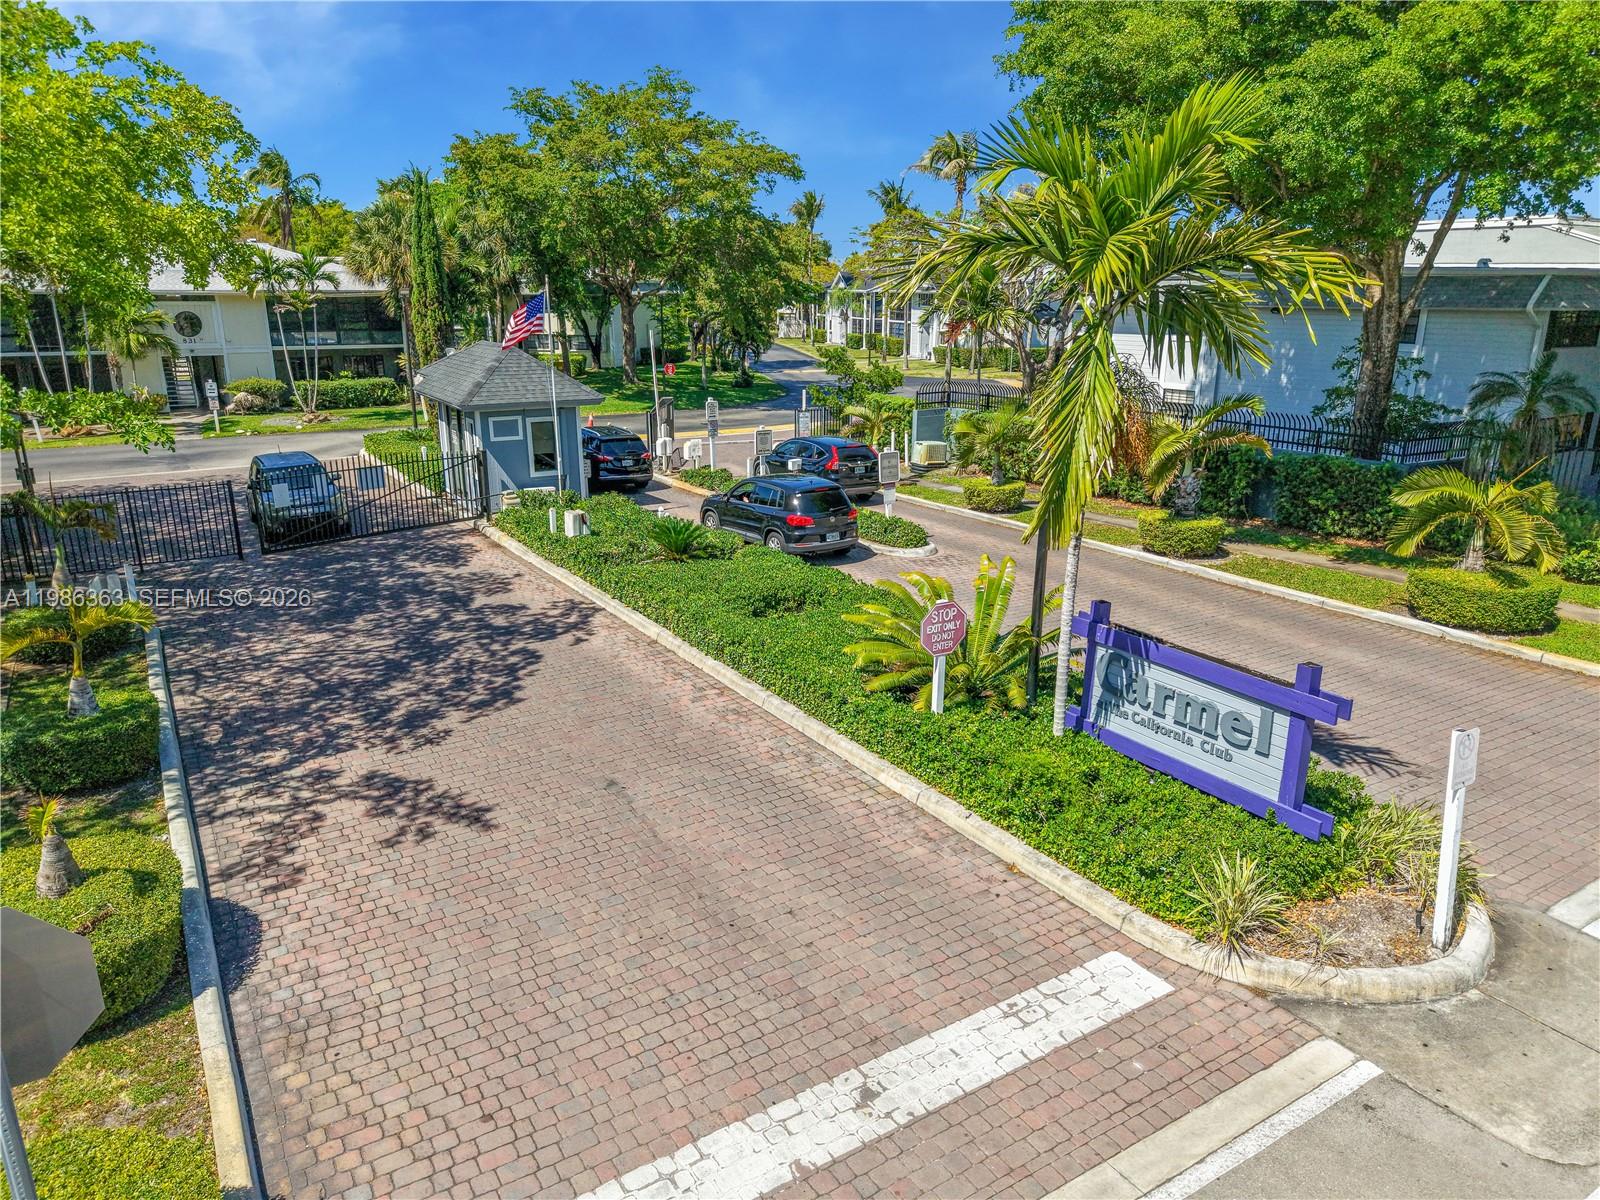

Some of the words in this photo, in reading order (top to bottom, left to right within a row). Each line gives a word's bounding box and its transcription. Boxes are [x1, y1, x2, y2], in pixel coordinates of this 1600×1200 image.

[931, 608, 957, 623] STOP
[927, 624, 942, 634] EXIT
[943, 620, 961, 631] ONLY
[932, 634, 942, 643] DO
[942, 631, 956, 640] NOT
[932, 641, 954, 651] ENTER
[1096, 650, 1274, 758] Carmel
[1131, 711, 1194, 747] California
[1200, 739, 1234, 763] Club
